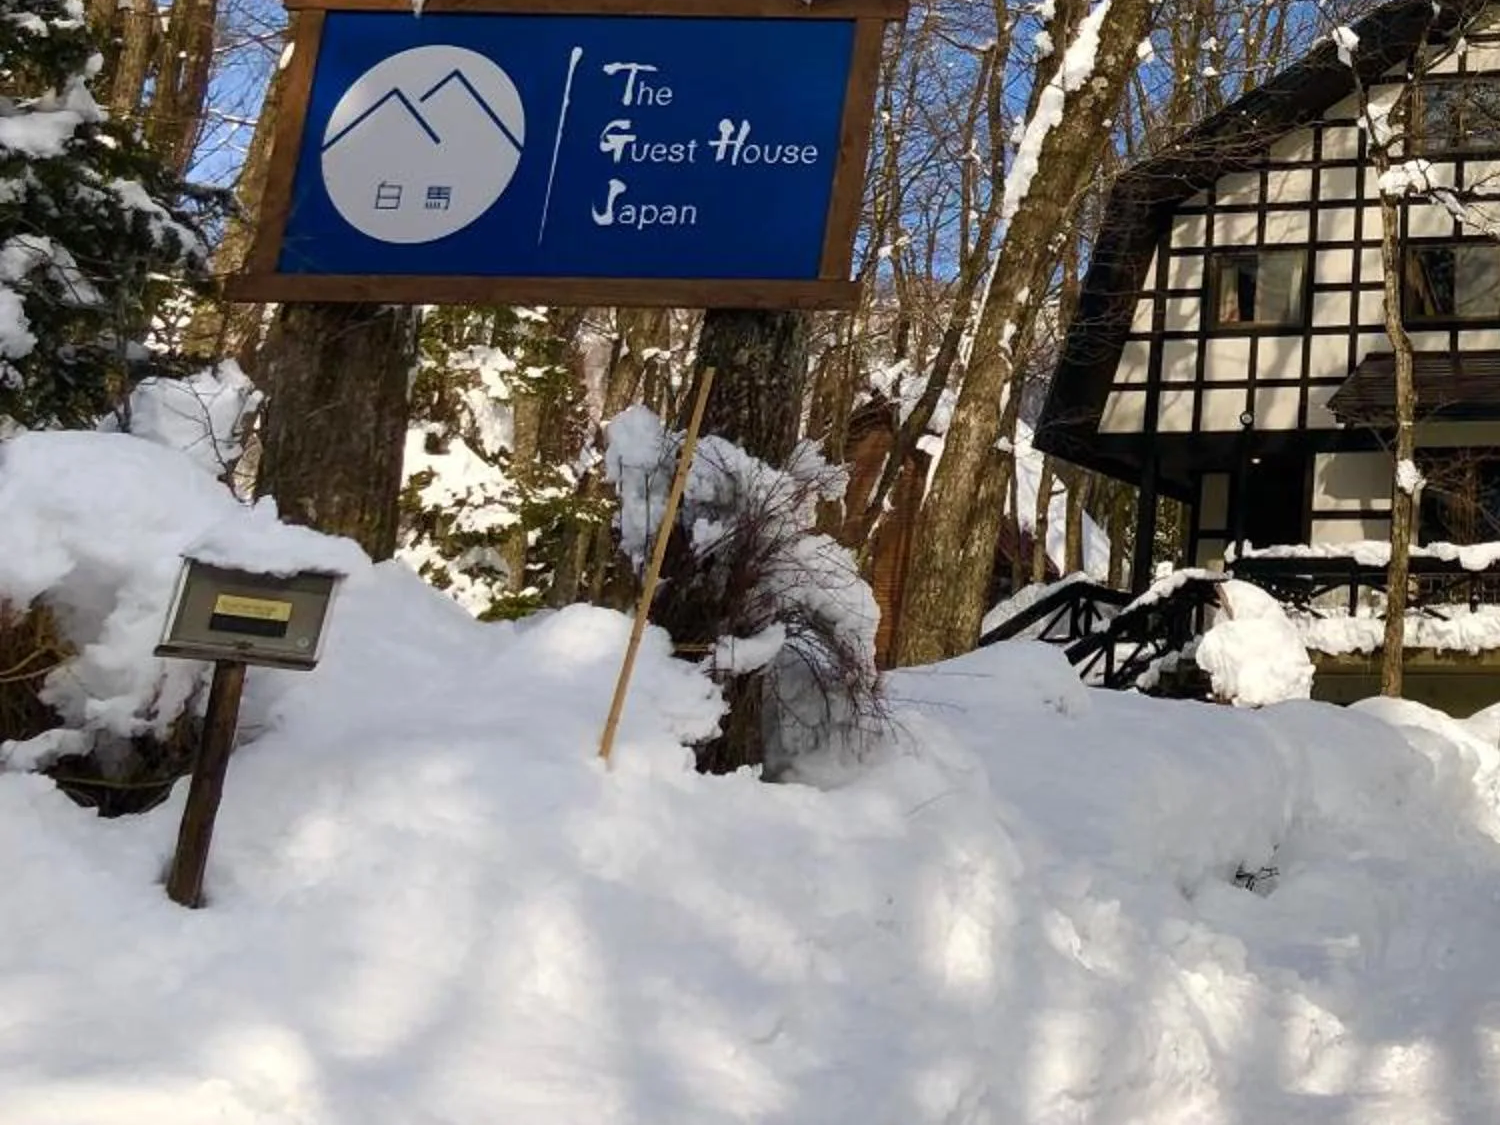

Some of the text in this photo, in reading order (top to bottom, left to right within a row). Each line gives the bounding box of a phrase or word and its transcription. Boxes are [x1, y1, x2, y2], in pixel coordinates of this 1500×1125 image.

[602, 61, 673, 106] The
[599, 118, 819, 166] Guest House
[591, 178, 698, 230] Japan
